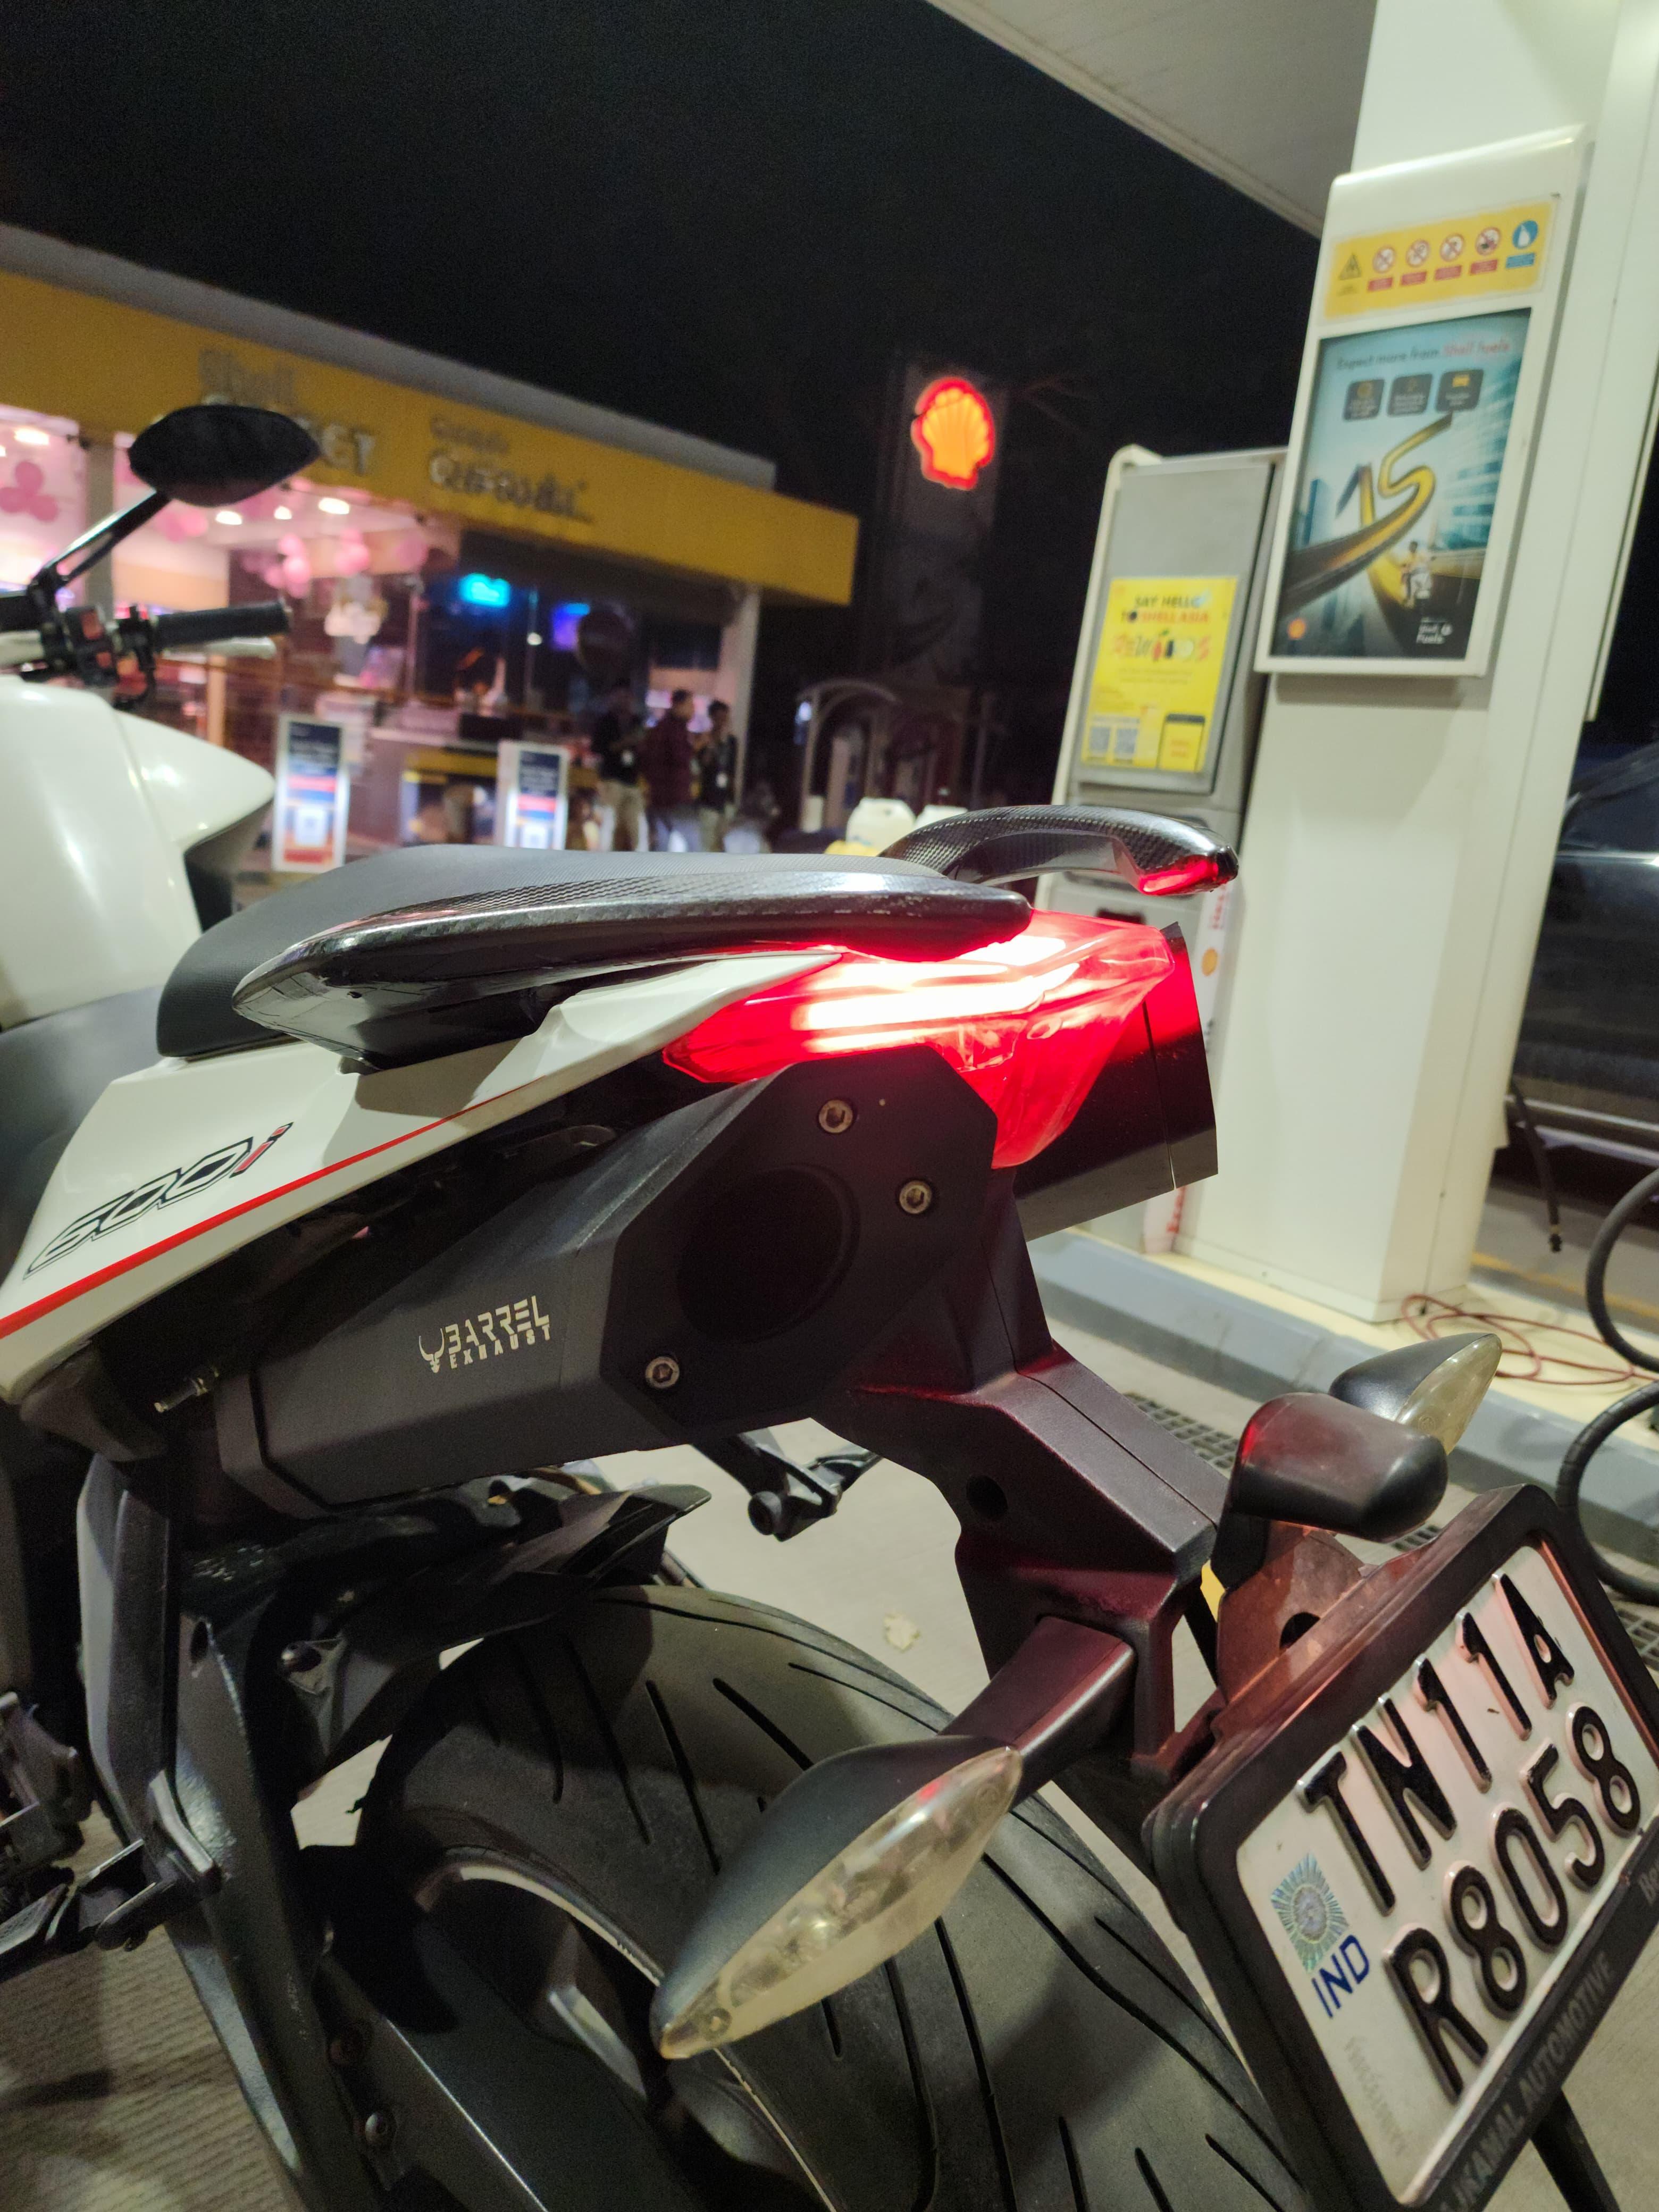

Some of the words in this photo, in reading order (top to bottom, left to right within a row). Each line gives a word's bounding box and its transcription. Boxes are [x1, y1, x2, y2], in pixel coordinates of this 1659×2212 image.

[445, 1295, 550, 1355] BARREL
[449, 1325, 550, 1370] EXHAUST
[1297, 1570, 1575, 1916] TN11A
[1382, 1703, 1640, 2103] R8058
[1311, 1933, 1370, 2018] IND
[1518, 1950, 1616, 2109] AUTOMOTIVE
